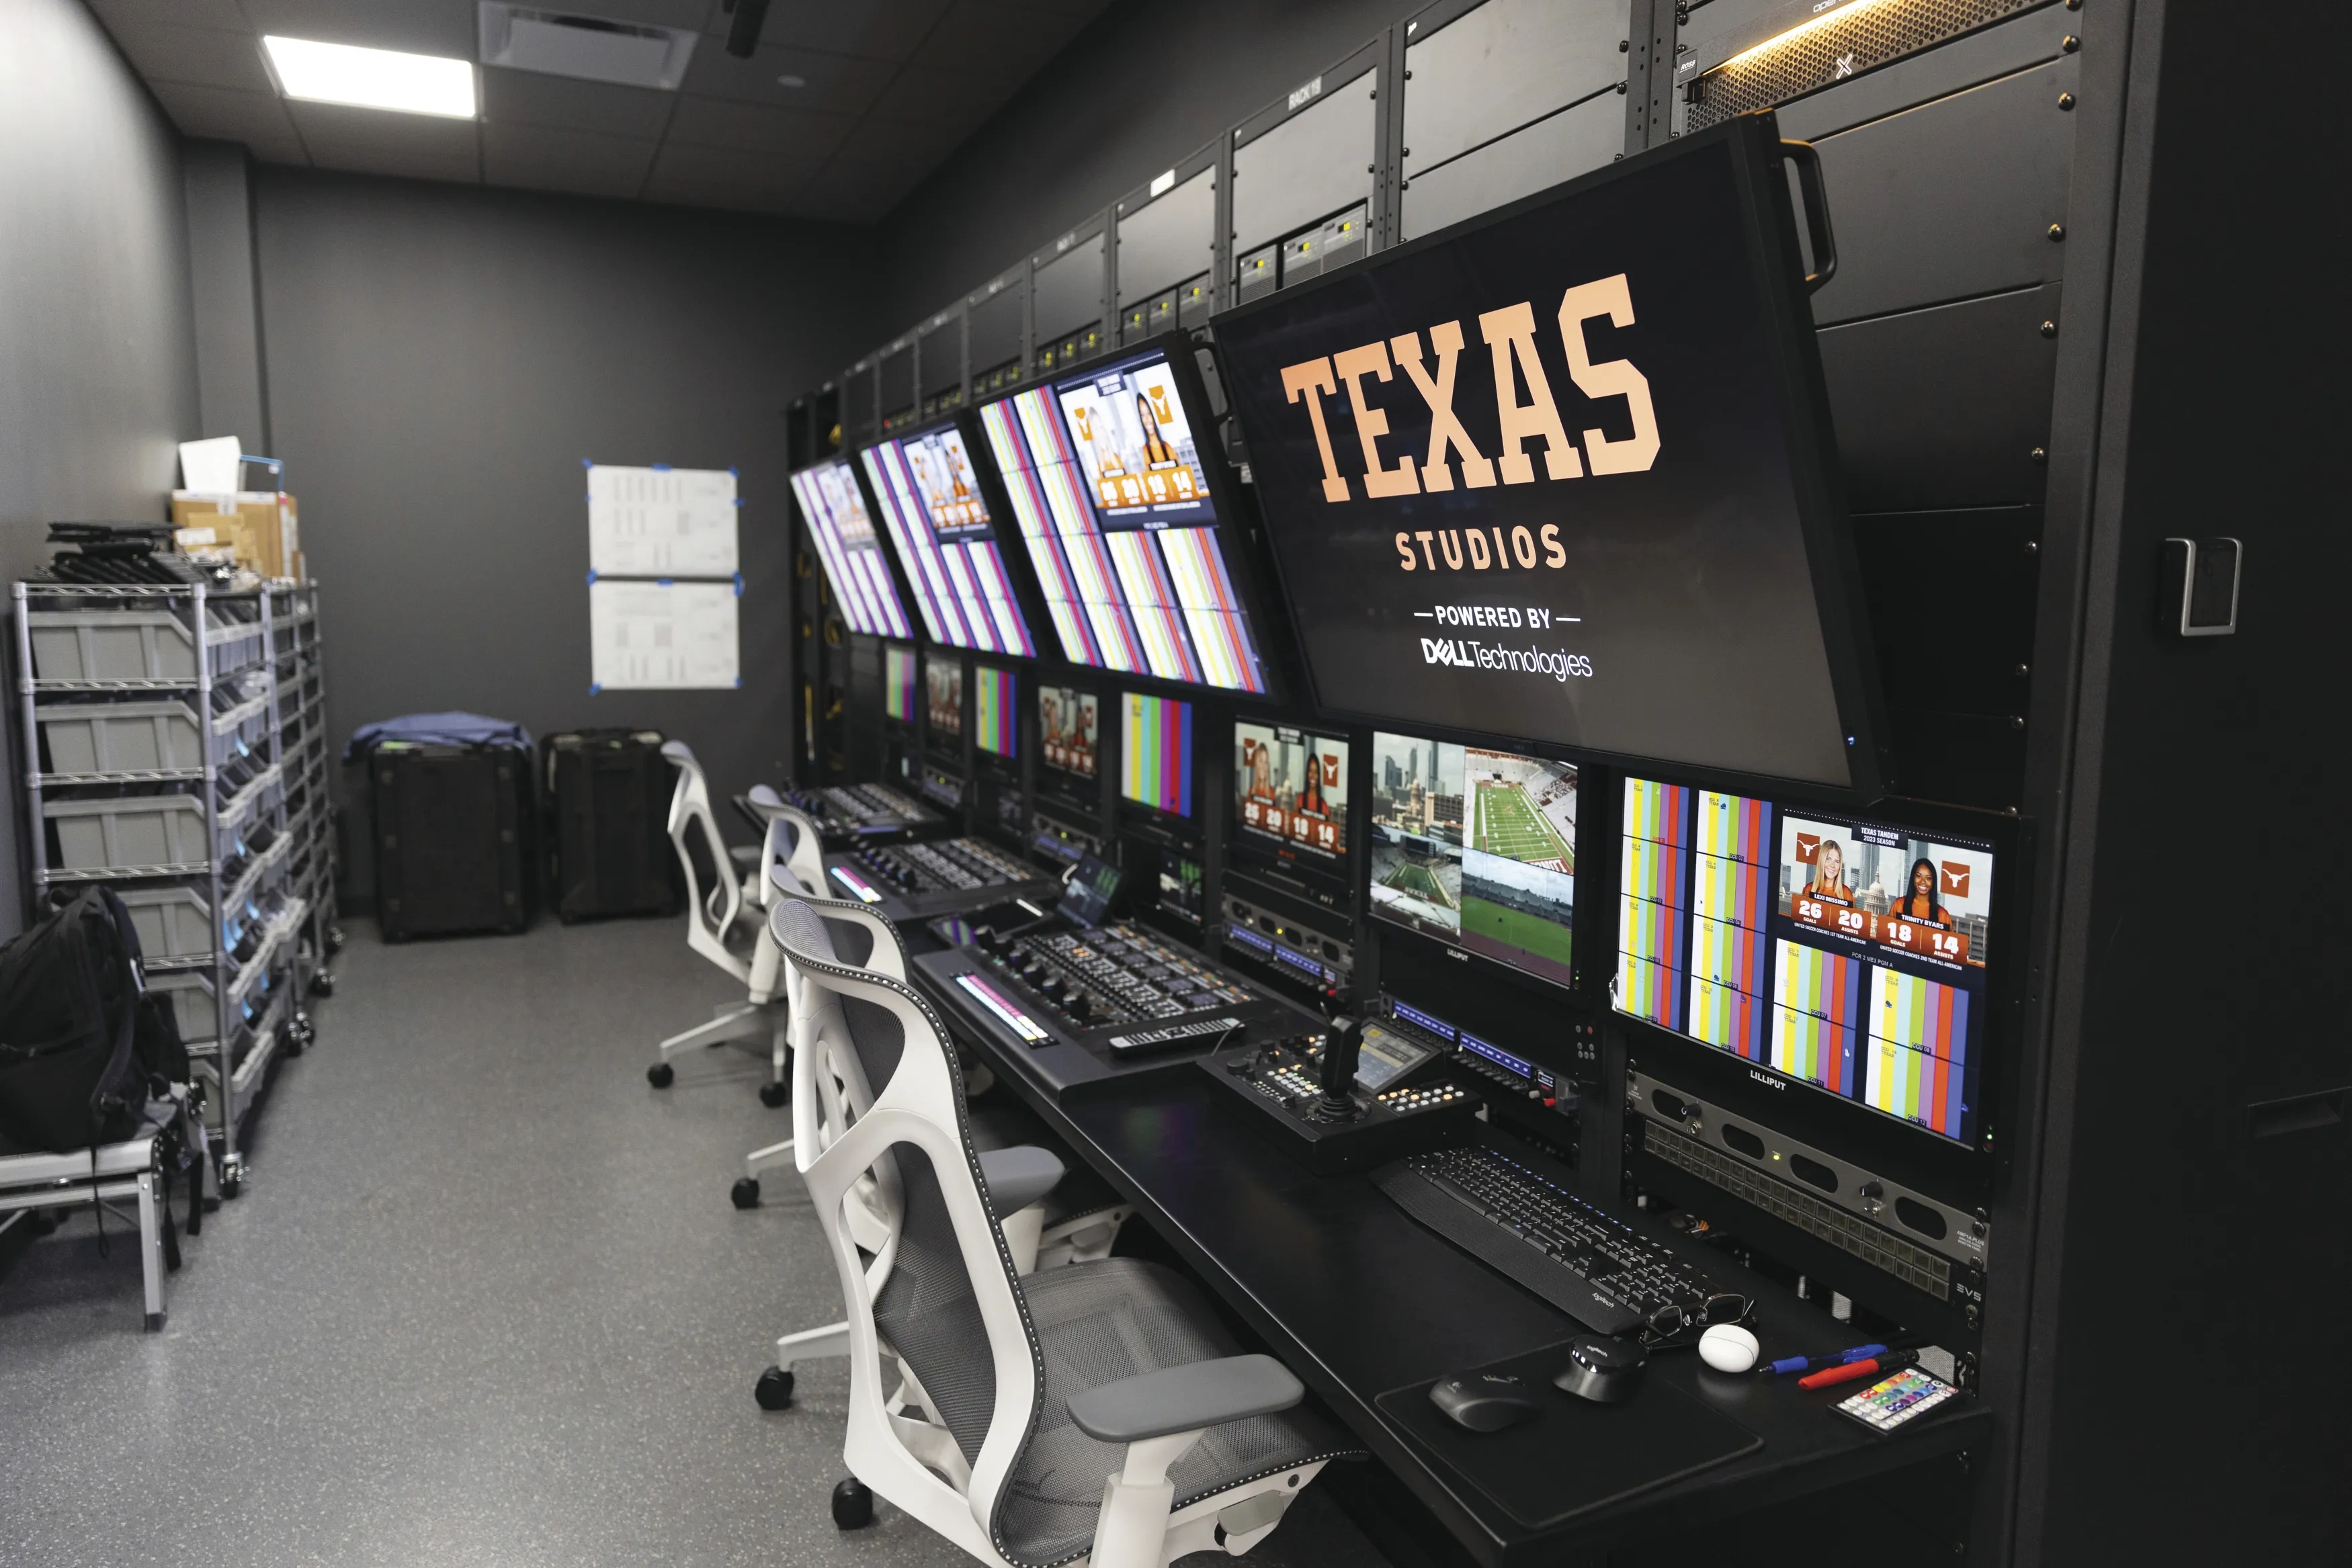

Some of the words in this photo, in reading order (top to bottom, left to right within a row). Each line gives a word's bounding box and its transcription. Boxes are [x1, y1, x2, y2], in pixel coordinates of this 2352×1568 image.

[1813, 0, 1841, 13] ope
[1680, 59, 1696, 71] ROSS
[1280, 273, 1661, 503] TEXAS
[1395, 524, 1566, 571] STUDIOS
[1435, 605, 1522, 628] POWERED
[1526, 607, 1550, 629] BY
[1421, 638, 1475, 667] DELL
[1467, 640, 1593, 683] Technologies
[1318, 824, 1335, 843] 14
[1861, 827, 1877, 836] TEXAS
[1878, 830, 1899, 840] TANDEM
[1876, 837, 1895, 846] SEASON
[1799, 900, 1822, 918] 26
[1825, 896, 1848, 906] MISSIMO
[1838, 910, 1863, 929] 20
[1901, 914, 1924, 924] TRINITY
[1924, 920, 1944, 929] BYARS
[1841, 926, 1859, 934] ASSISTS
[1887, 922, 1912, 942] 18
[1845, 935, 1866, 945] ALL-AMERICAN
[1890, 939, 1906, 947] GOALS
[1932, 933, 1959, 954] 14
[1851, 951, 1862, 959] PCR
[1878, 959, 1888, 967] PGM
[1892, 948, 1905, 956] SOCCER
[1905, 951, 1920, 960] COACHES
[1938, 961, 1962, 971] ALL-AMERICAN
[1933, 951, 1954, 959] ASSISTS
[1750, 1070, 1786, 1091] LILLIPUT
[1592, 1292, 1614, 1308] logitech
[1956, 1282, 1982, 1302] EVS
[1586, 1344, 1608, 1358] logitech
